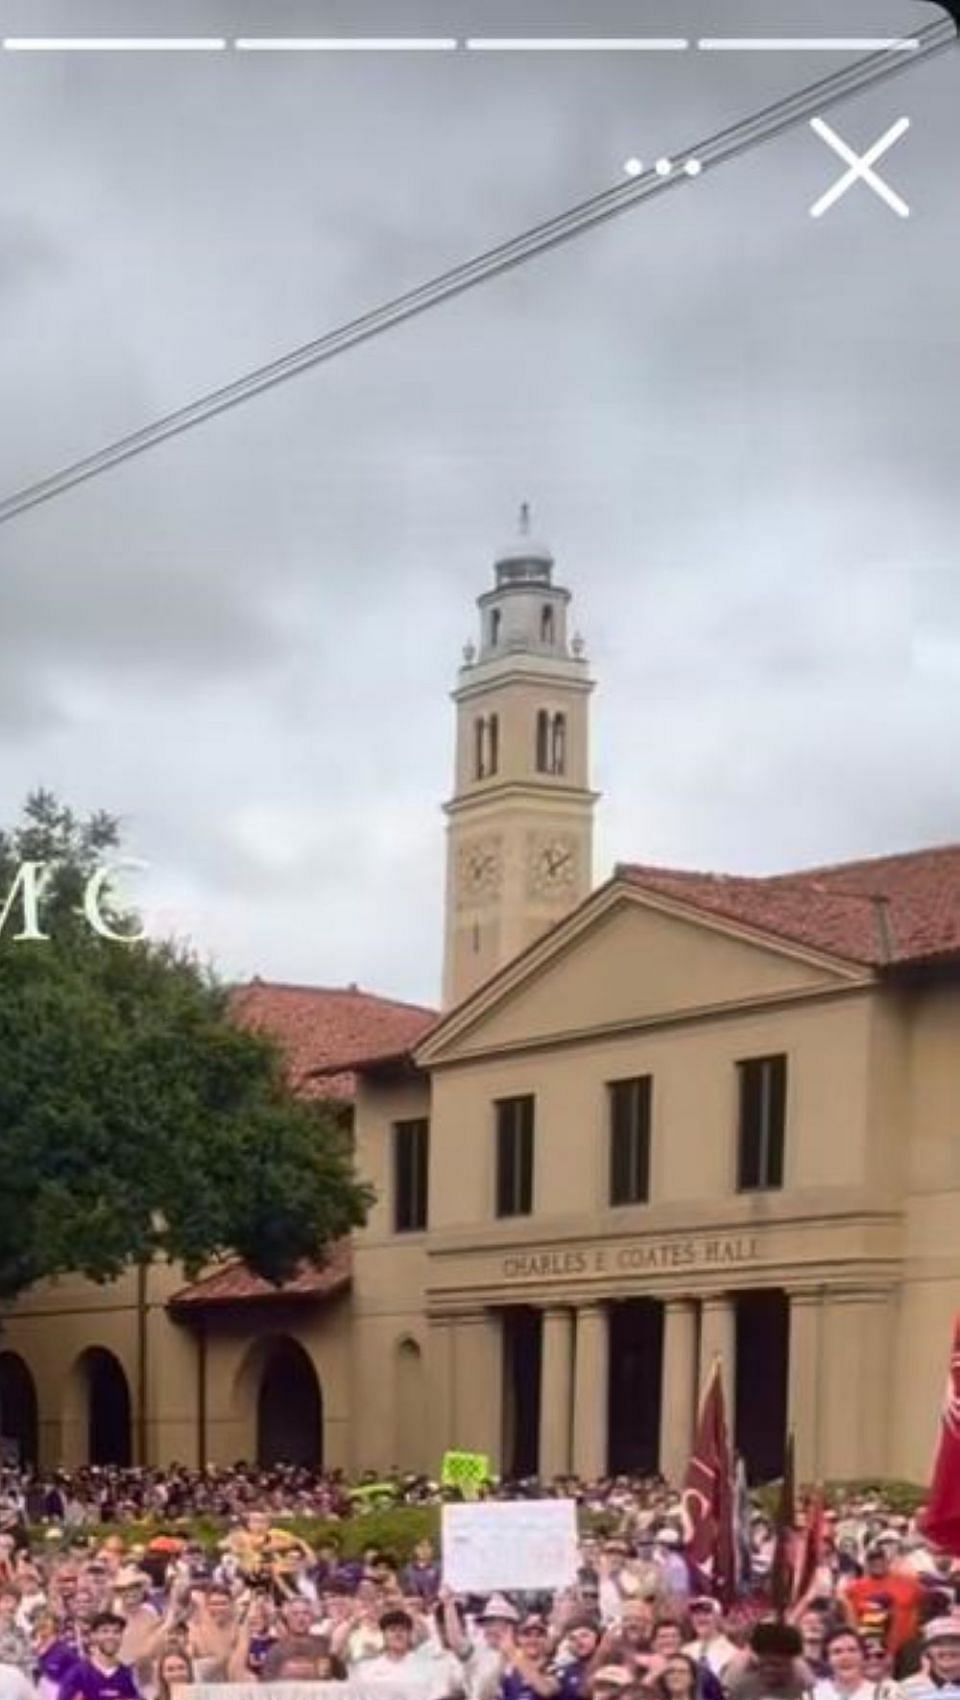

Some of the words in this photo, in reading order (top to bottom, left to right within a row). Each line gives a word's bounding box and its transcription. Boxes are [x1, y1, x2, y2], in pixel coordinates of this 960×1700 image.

[502, 1250, 587, 1278] CHARLES
[616, 1243, 697, 1271] COATES
[704, 1238, 762, 1262] HALL
